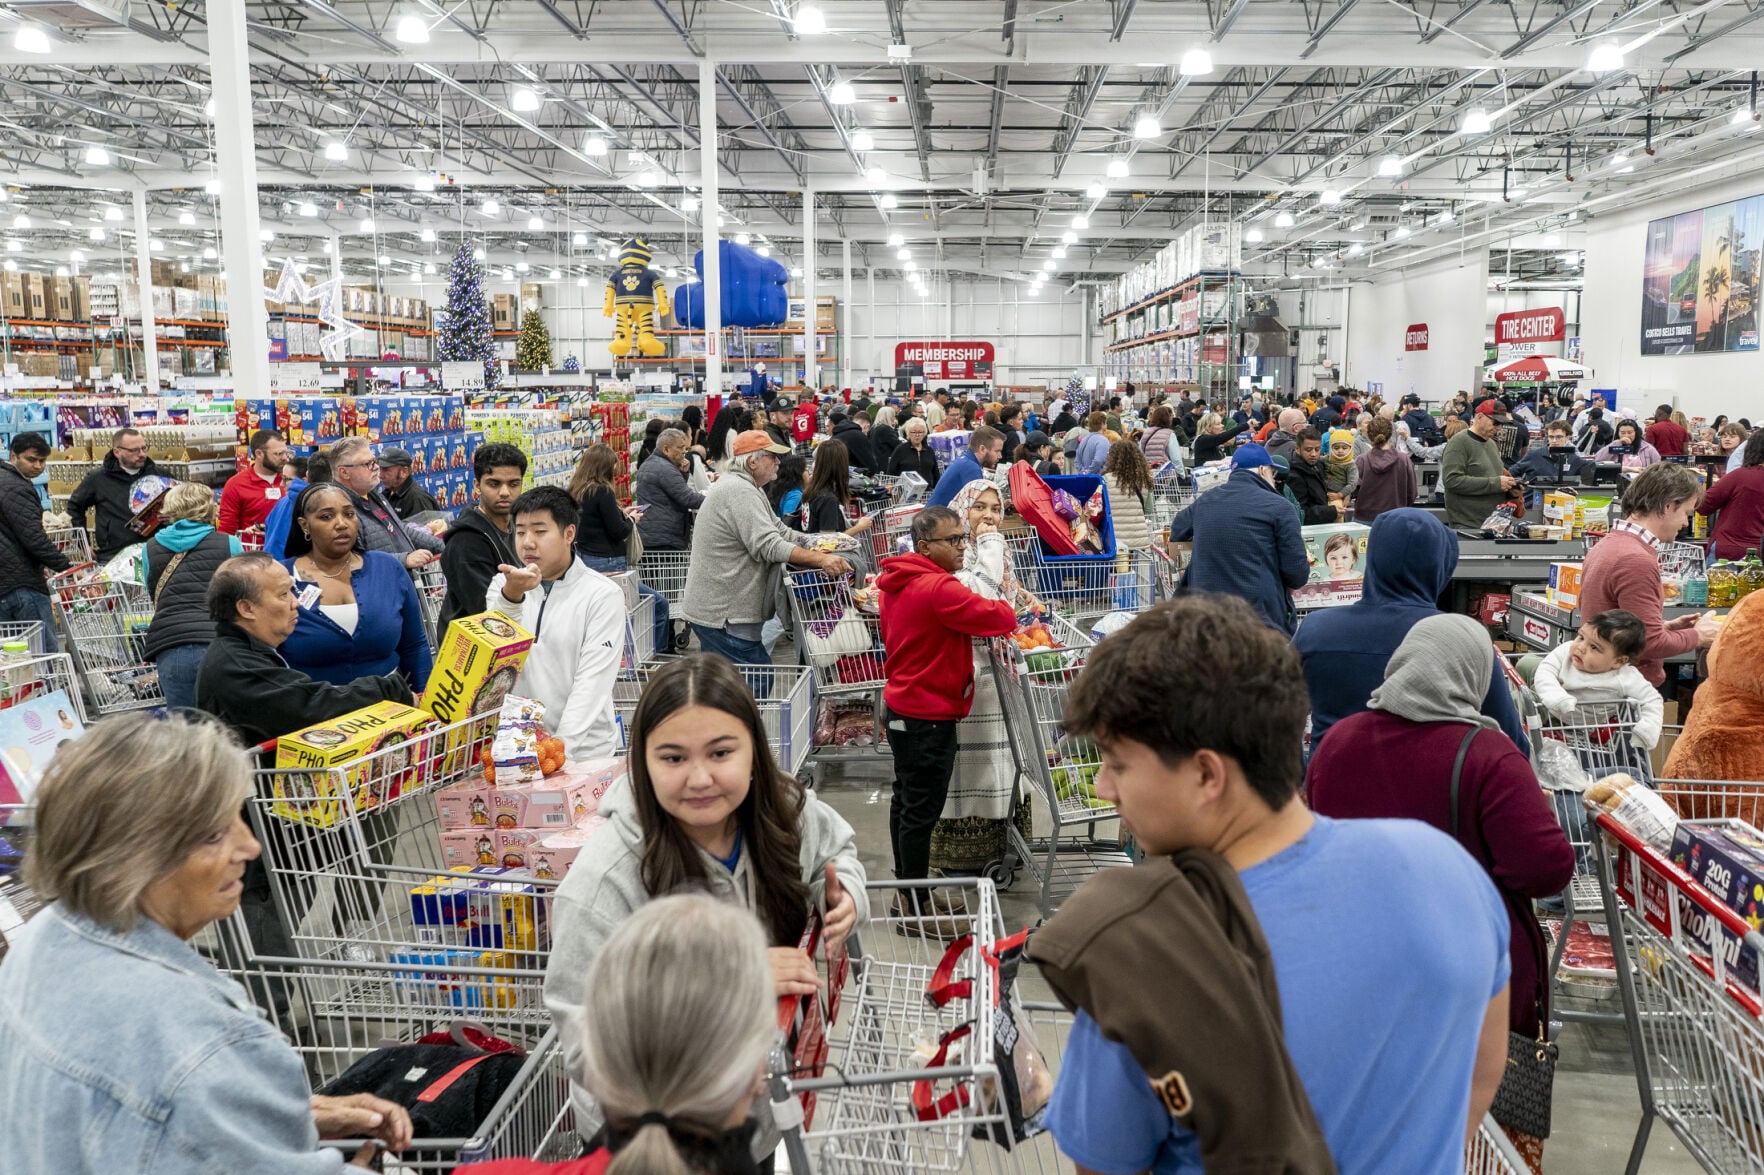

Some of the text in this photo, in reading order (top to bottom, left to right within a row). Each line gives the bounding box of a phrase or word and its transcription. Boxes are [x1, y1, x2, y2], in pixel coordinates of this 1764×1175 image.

[1502, 315, 1556, 340] TIRE CENTER
[1662, 327, 1676, 337] SELLS
[1675, 325, 1692, 336] TRAVEL
[1406, 331, 1428, 345] RETURNS
[904, 347, 986, 361] MEMBERSHIP
[1510, 343, 1536, 351] OWER
[299, 379, 320, 388] 12.69
[462, 379, 484, 387] 14.89
[459, 620, 486, 635] PHO
[431, 669, 464, 724] PHO
[336, 714, 387, 734] PHO
[298, 751, 325, 768] PHO
[1705, 859, 1731, 889] 20G
[1703, 876, 1728, 901] Protein
[1678, 894, 1742, 968] Chobni
